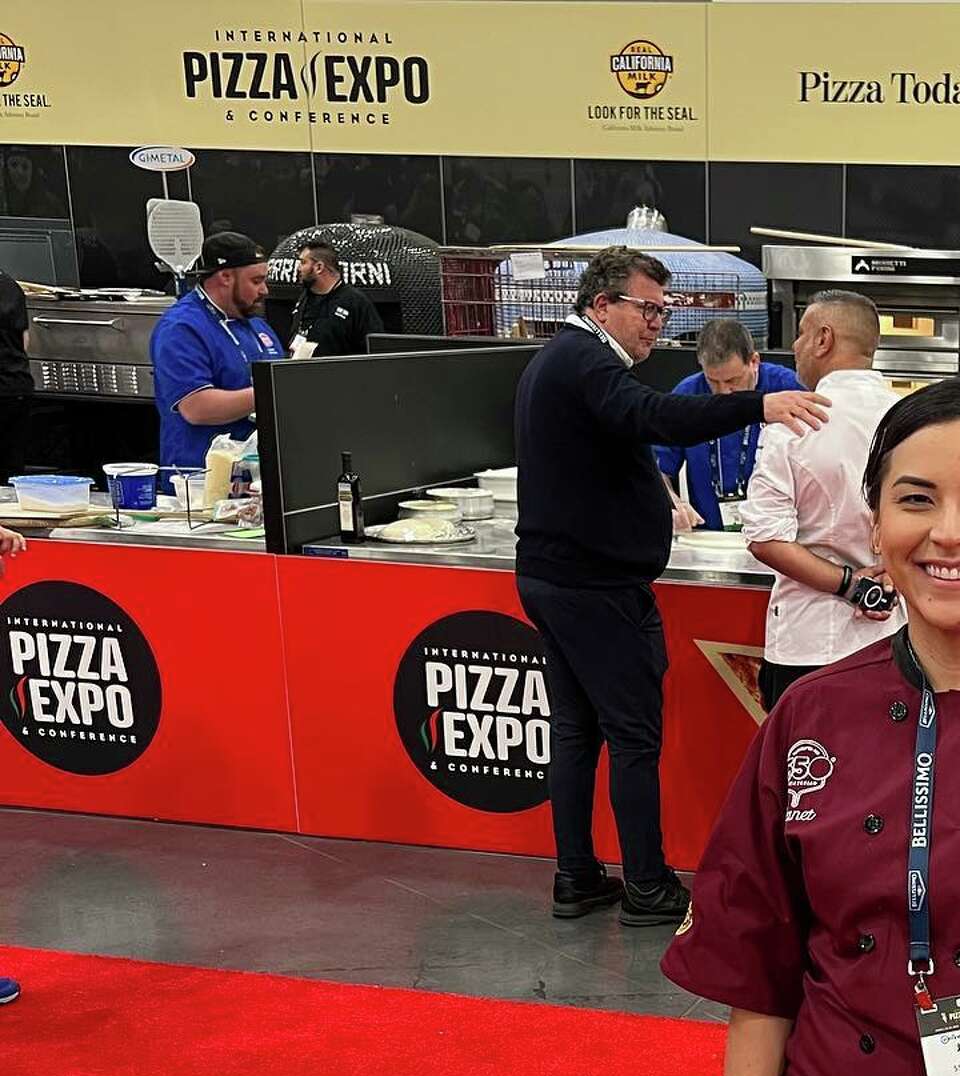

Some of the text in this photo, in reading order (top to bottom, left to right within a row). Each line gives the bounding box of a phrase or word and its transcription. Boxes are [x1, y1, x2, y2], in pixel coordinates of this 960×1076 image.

[215, 30, 393, 44] INTERNATIONAL
[612, 56, 672, 72] CALIFORNIA
[183, 51, 430, 104] PIZZA EXPO
[627, 72, 656, 81] MILK
[797, 71, 885, 103] Pizza
[2, 94, 22, 107] THE
[225, 109, 390, 125] & CONFERENCE
[587, 105, 617, 120] LOOK
[619, 105, 641, 120] FOR
[643, 106, 665, 120] THE
[138, 153, 186, 163] GIMETAL
[7, 616, 123, 633] INTERNATIONAL
[8, 630, 129, 683] PIZZA
[425, 661, 551, 717] PIZZA
[28, 677, 135, 729] EXPO
[38, 728, 137, 744] CONFERENCE
[442, 711, 551, 765] EXPO
[430, 760, 545, 780] & CONFERENC
[911, 752, 933, 849] BELLISSIMO
[785, 808, 817, 822] anet
